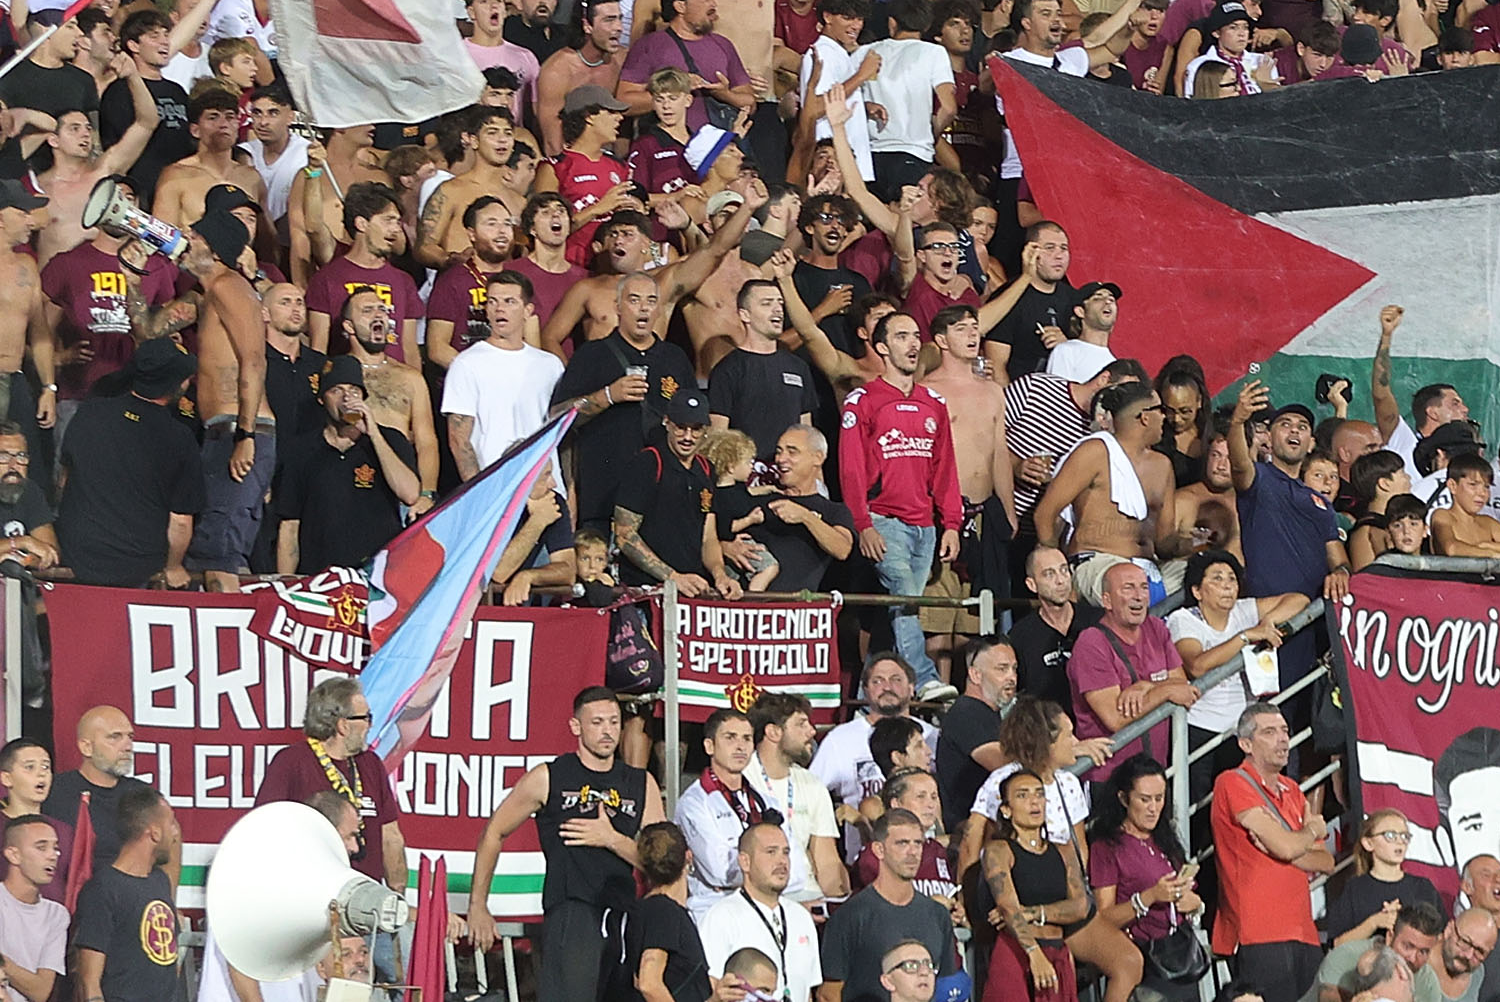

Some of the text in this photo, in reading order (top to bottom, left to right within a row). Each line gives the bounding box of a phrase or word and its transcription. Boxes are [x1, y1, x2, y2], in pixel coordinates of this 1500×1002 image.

[696, 605, 832, 640] PIROTECNICA
[688, 640, 830, 676] SPETTACOLO
[1338, 592, 1392, 679] in
[1396, 607, 1500, 714] ogni
